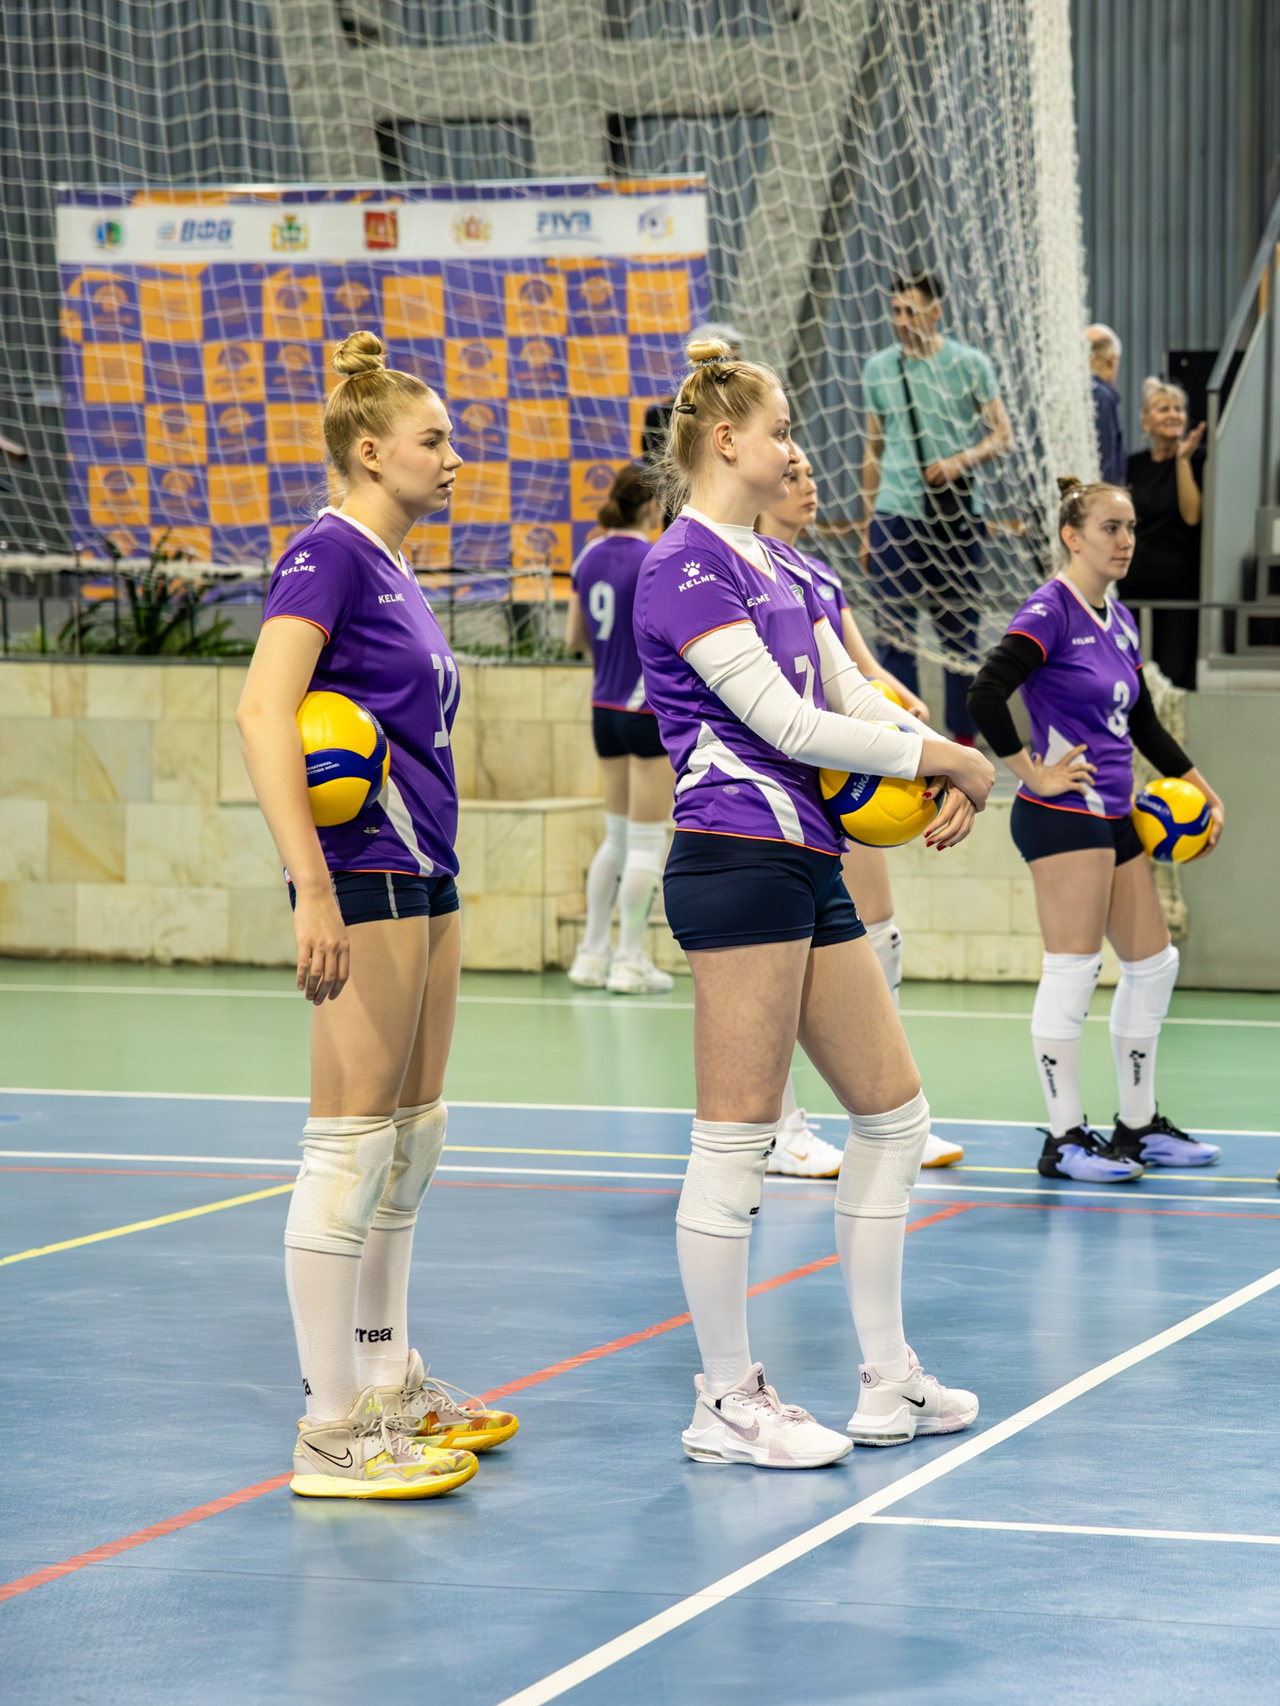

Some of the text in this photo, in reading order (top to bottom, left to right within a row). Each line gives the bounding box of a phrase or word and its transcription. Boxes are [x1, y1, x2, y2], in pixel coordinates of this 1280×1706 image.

[281, 565, 316, 577] KELME
[678, 573, 717, 592] KELME
[377, 593, 406, 604] KELME
[589, 580, 615, 641] 9
[1107, 680, 1131, 738] 3
